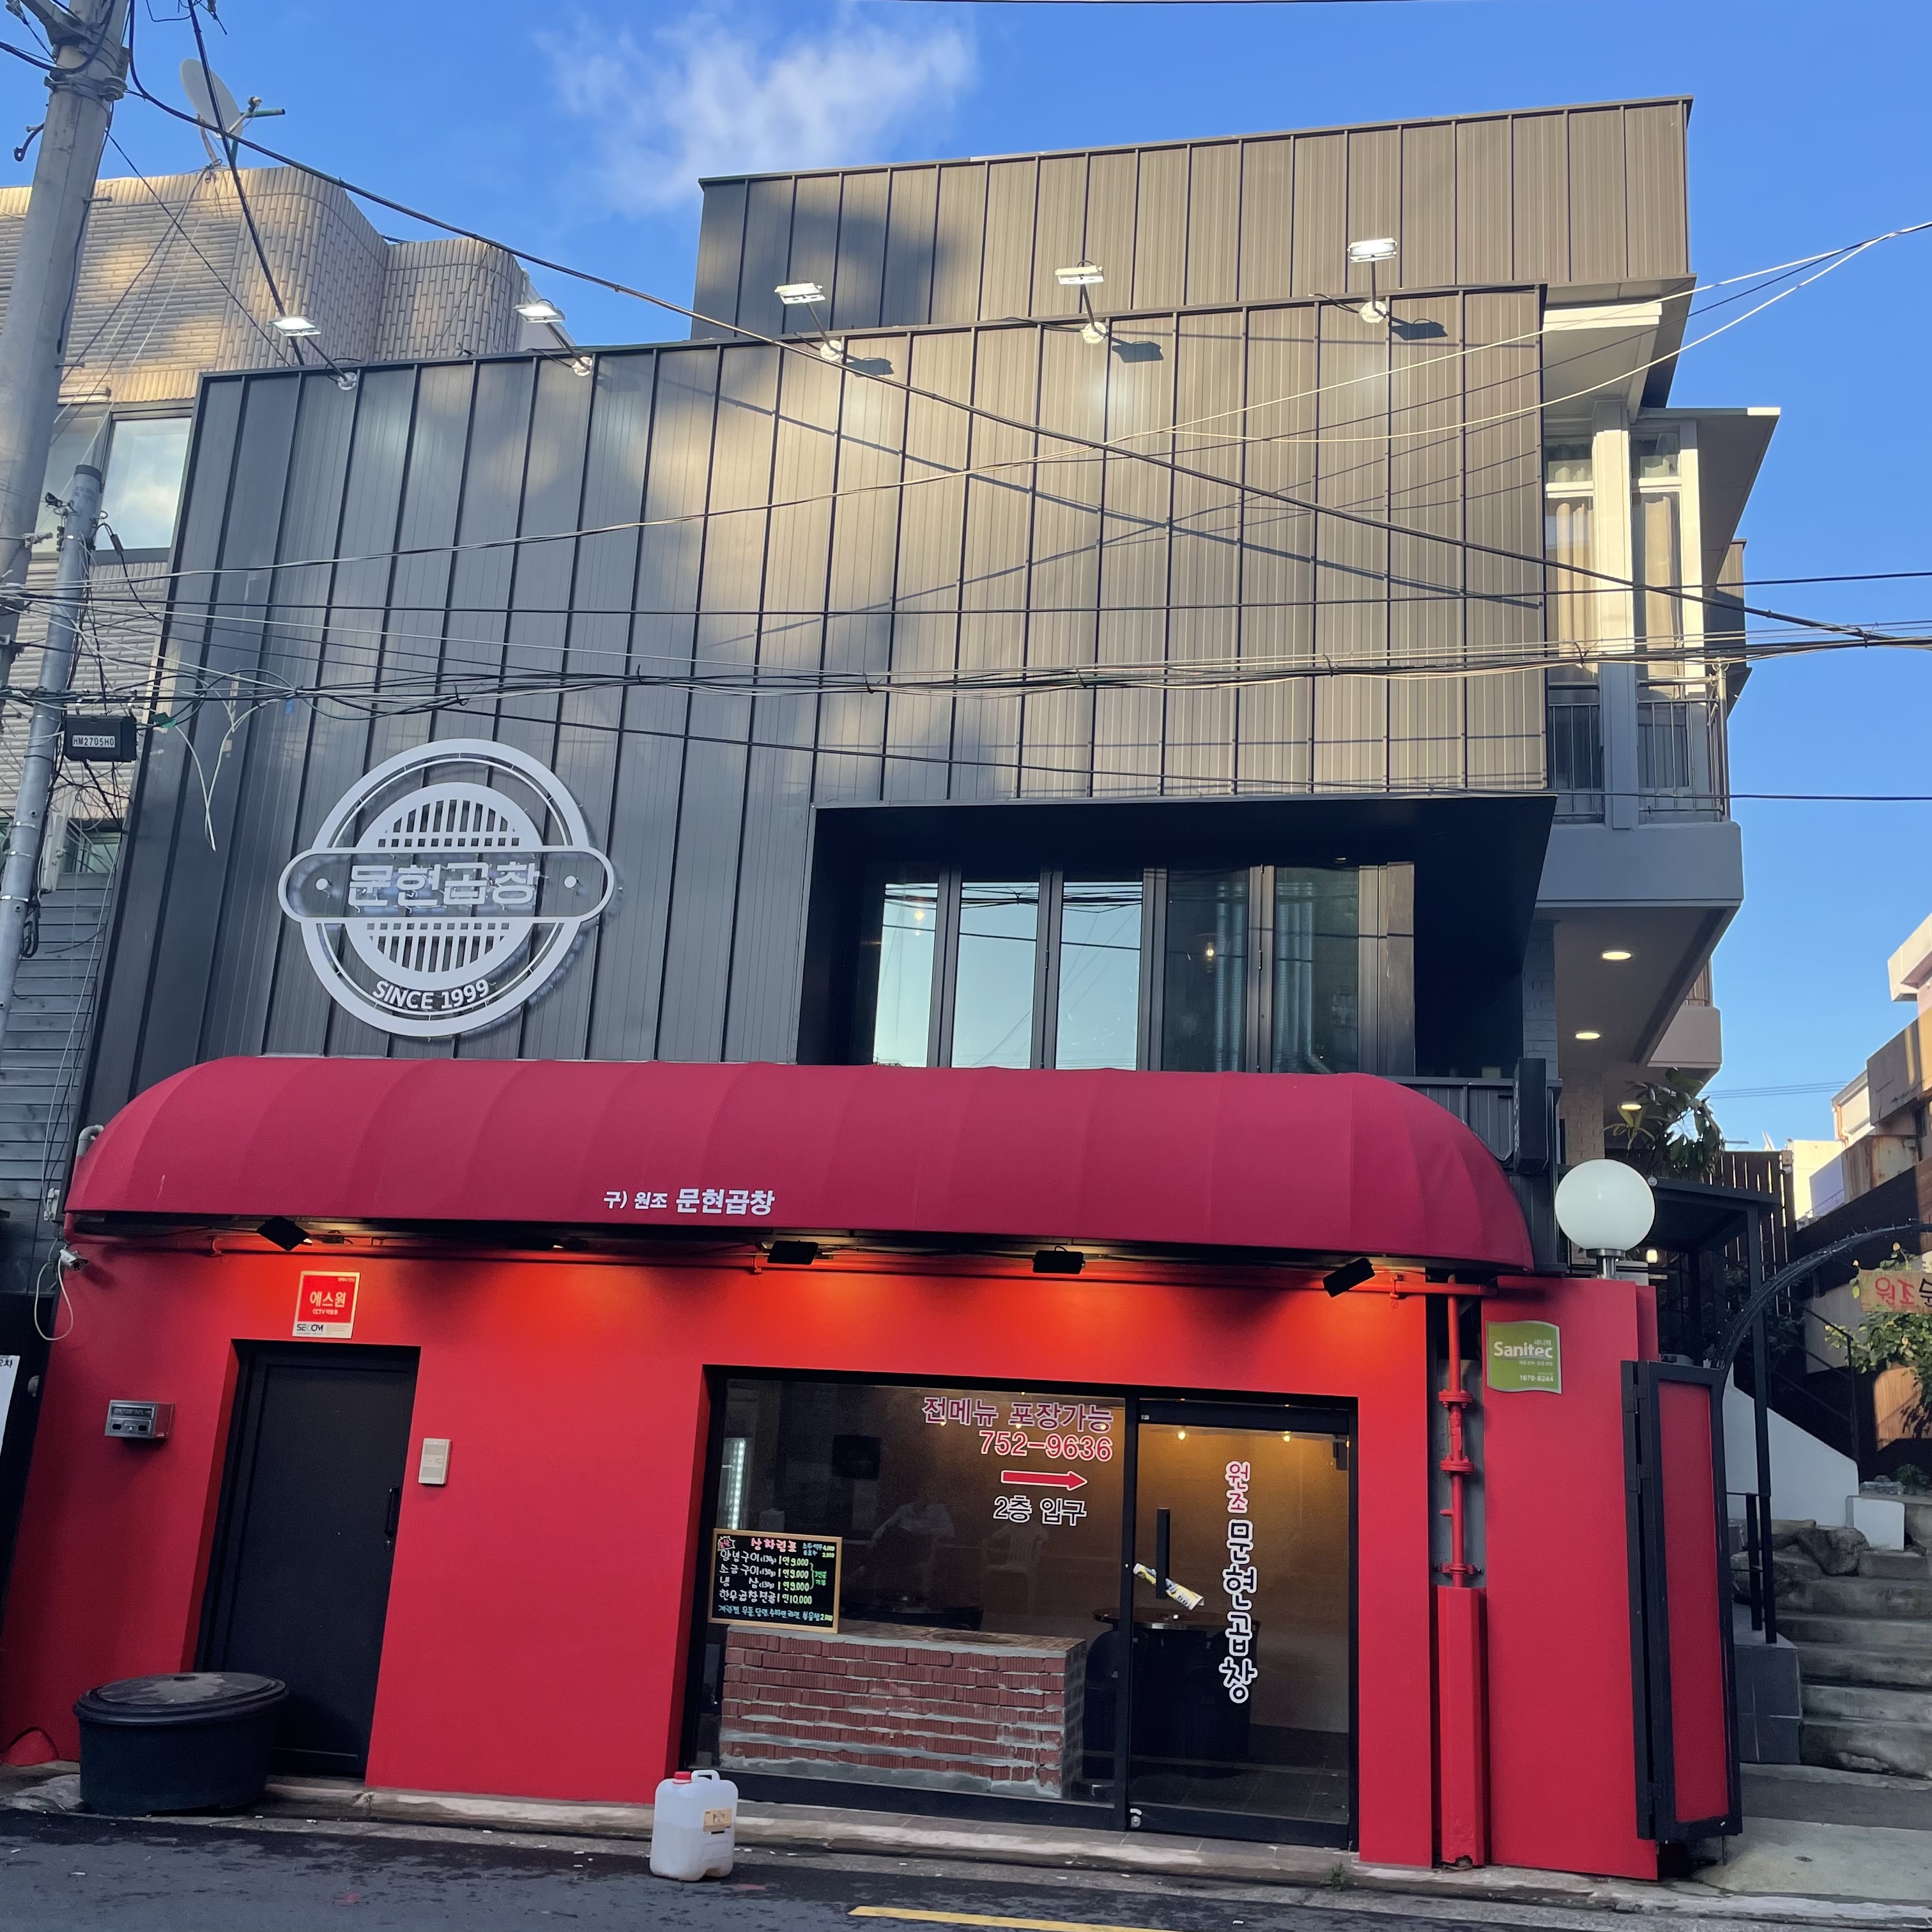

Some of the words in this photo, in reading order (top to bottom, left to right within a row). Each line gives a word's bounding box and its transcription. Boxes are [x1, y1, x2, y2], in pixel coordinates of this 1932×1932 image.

[348, 861, 539, 907] 문현곱창
[372, 980, 434, 1010] SINCE
[440, 978, 490, 1009] 1999
[603, 1190, 628, 1209] 구)
[634, 1191, 668, 1210] 원조
[675, 1188, 776, 1216] 문현곱창
[309, 1291, 346, 1308] 에스원
[1874, 1276, 1915, 1306] 원조
[296, 1323, 324, 1332] SECOM
[1493, 1340, 1553, 1359] Sanitec
[922, 1396, 999, 1427] 전메뉴
[1008, 1402, 1114, 1434] 포장가능
[978, 1430, 1114, 1462] 752-9636
[1224, 1460, 1251, 1514] 원조
[993, 1494, 1033, 1523] 2층
[1039, 1498, 1087, 1526] 입구
[1218, 1518, 1259, 1705] 문현곱창
